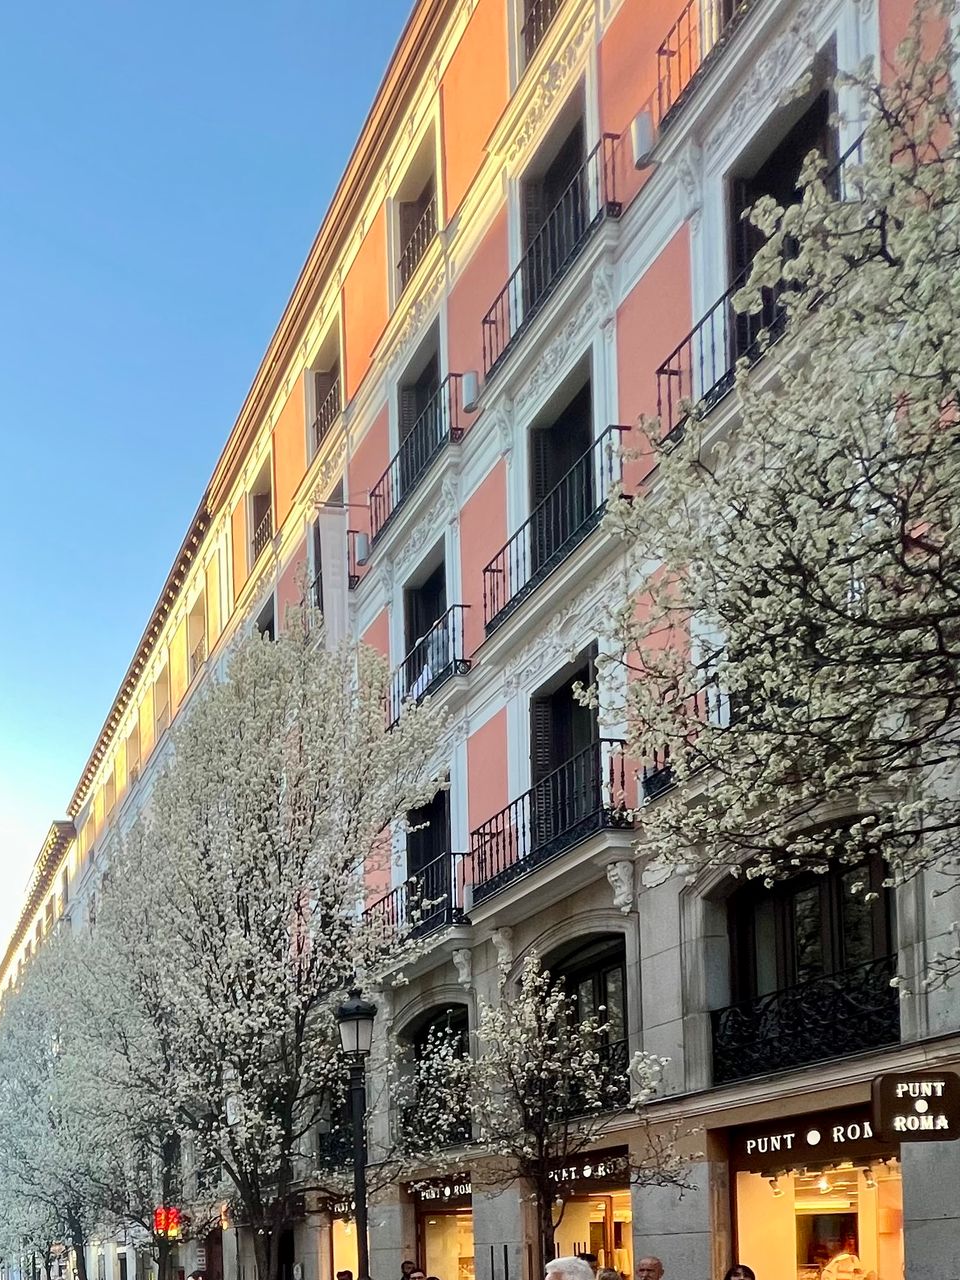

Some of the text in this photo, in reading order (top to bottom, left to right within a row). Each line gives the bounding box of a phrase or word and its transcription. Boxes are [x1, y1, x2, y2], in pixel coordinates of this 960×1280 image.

[896, 1081, 945, 1098] PUNT
[893, 1115, 949, 1131] ROMA
[746, 1121, 873, 1154] PUNT ROM
[453, 1183, 472, 1195] ROM
